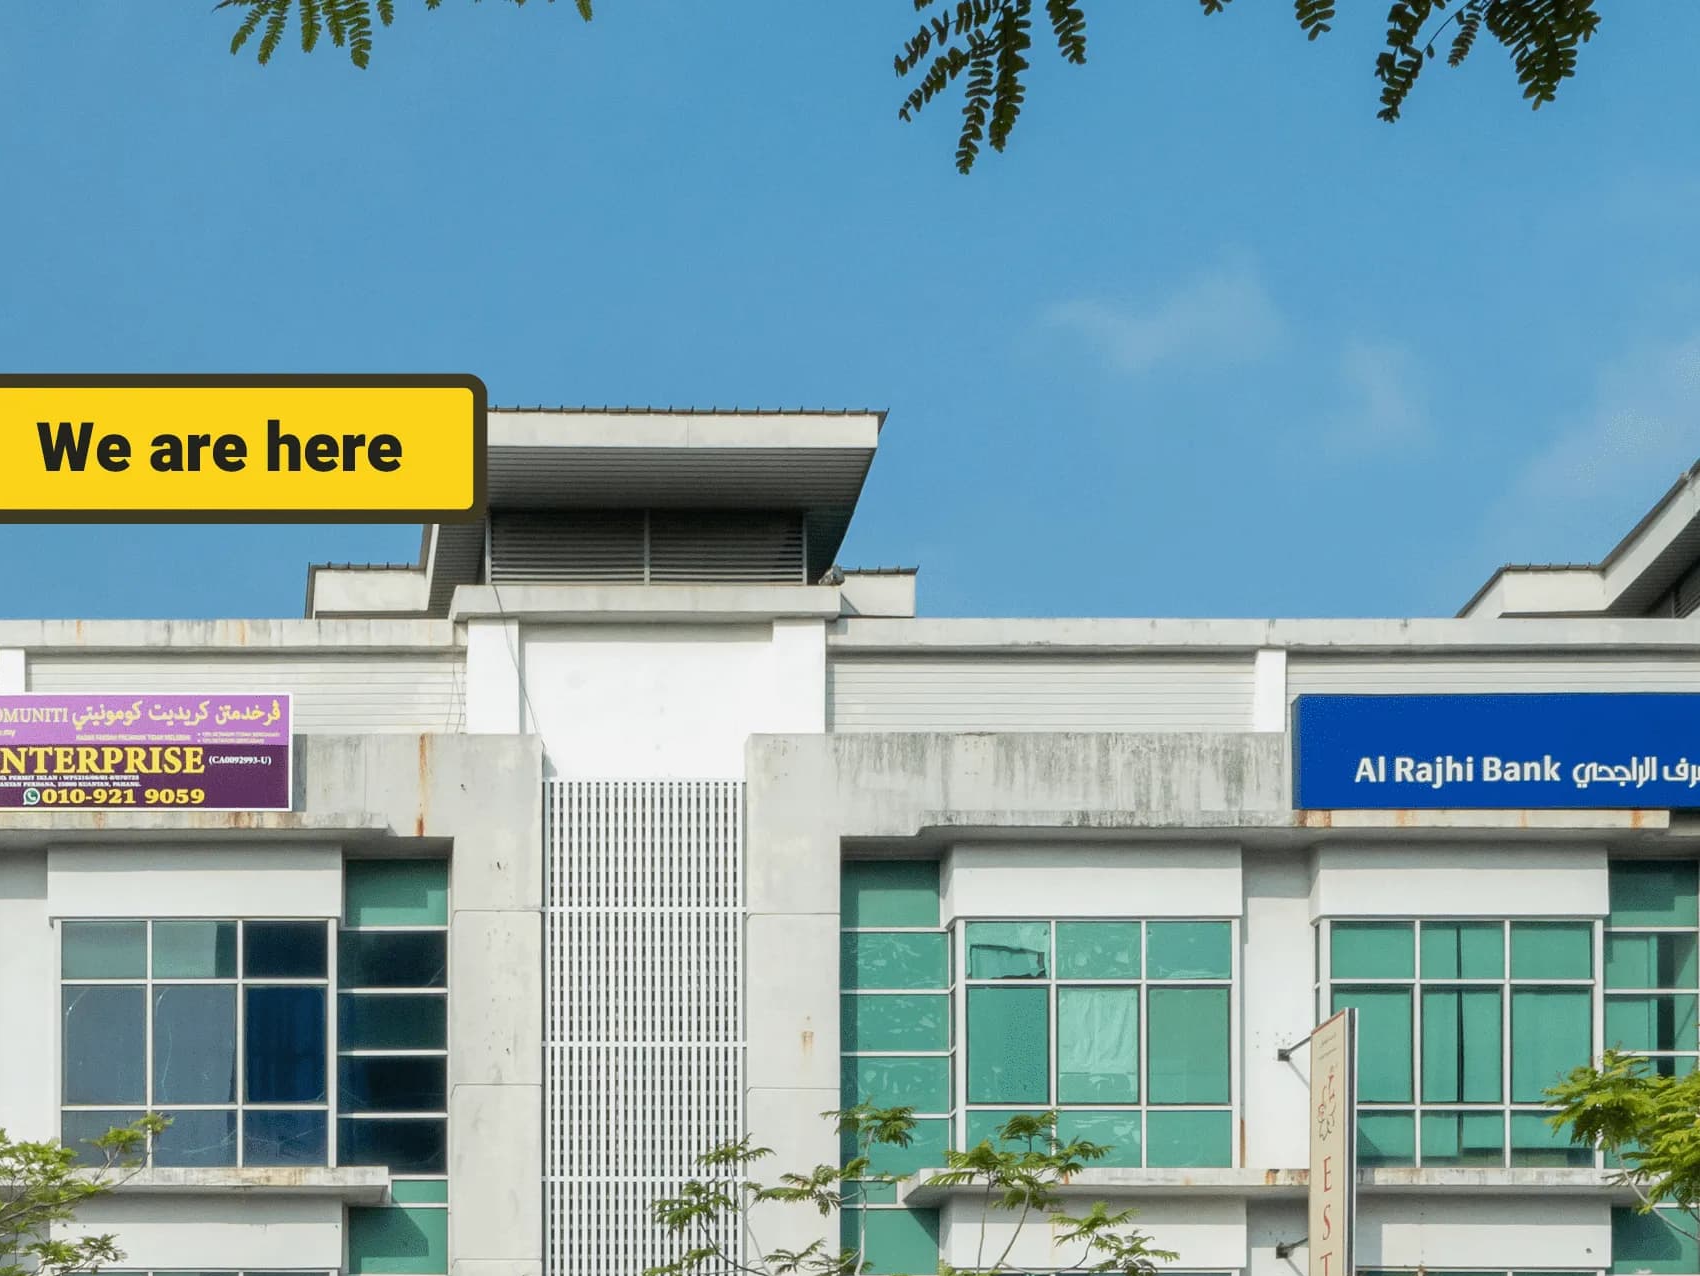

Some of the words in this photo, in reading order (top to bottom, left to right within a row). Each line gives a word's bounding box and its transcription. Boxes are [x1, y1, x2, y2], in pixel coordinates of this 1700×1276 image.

[1354, 756, 1386, 783] Al
[1394, 756, 1474, 789] Rajhi
[1482, 755, 1561, 783] Bank
[41, 788, 136, 804] 010-921
[144, 788, 205, 804] 9059
